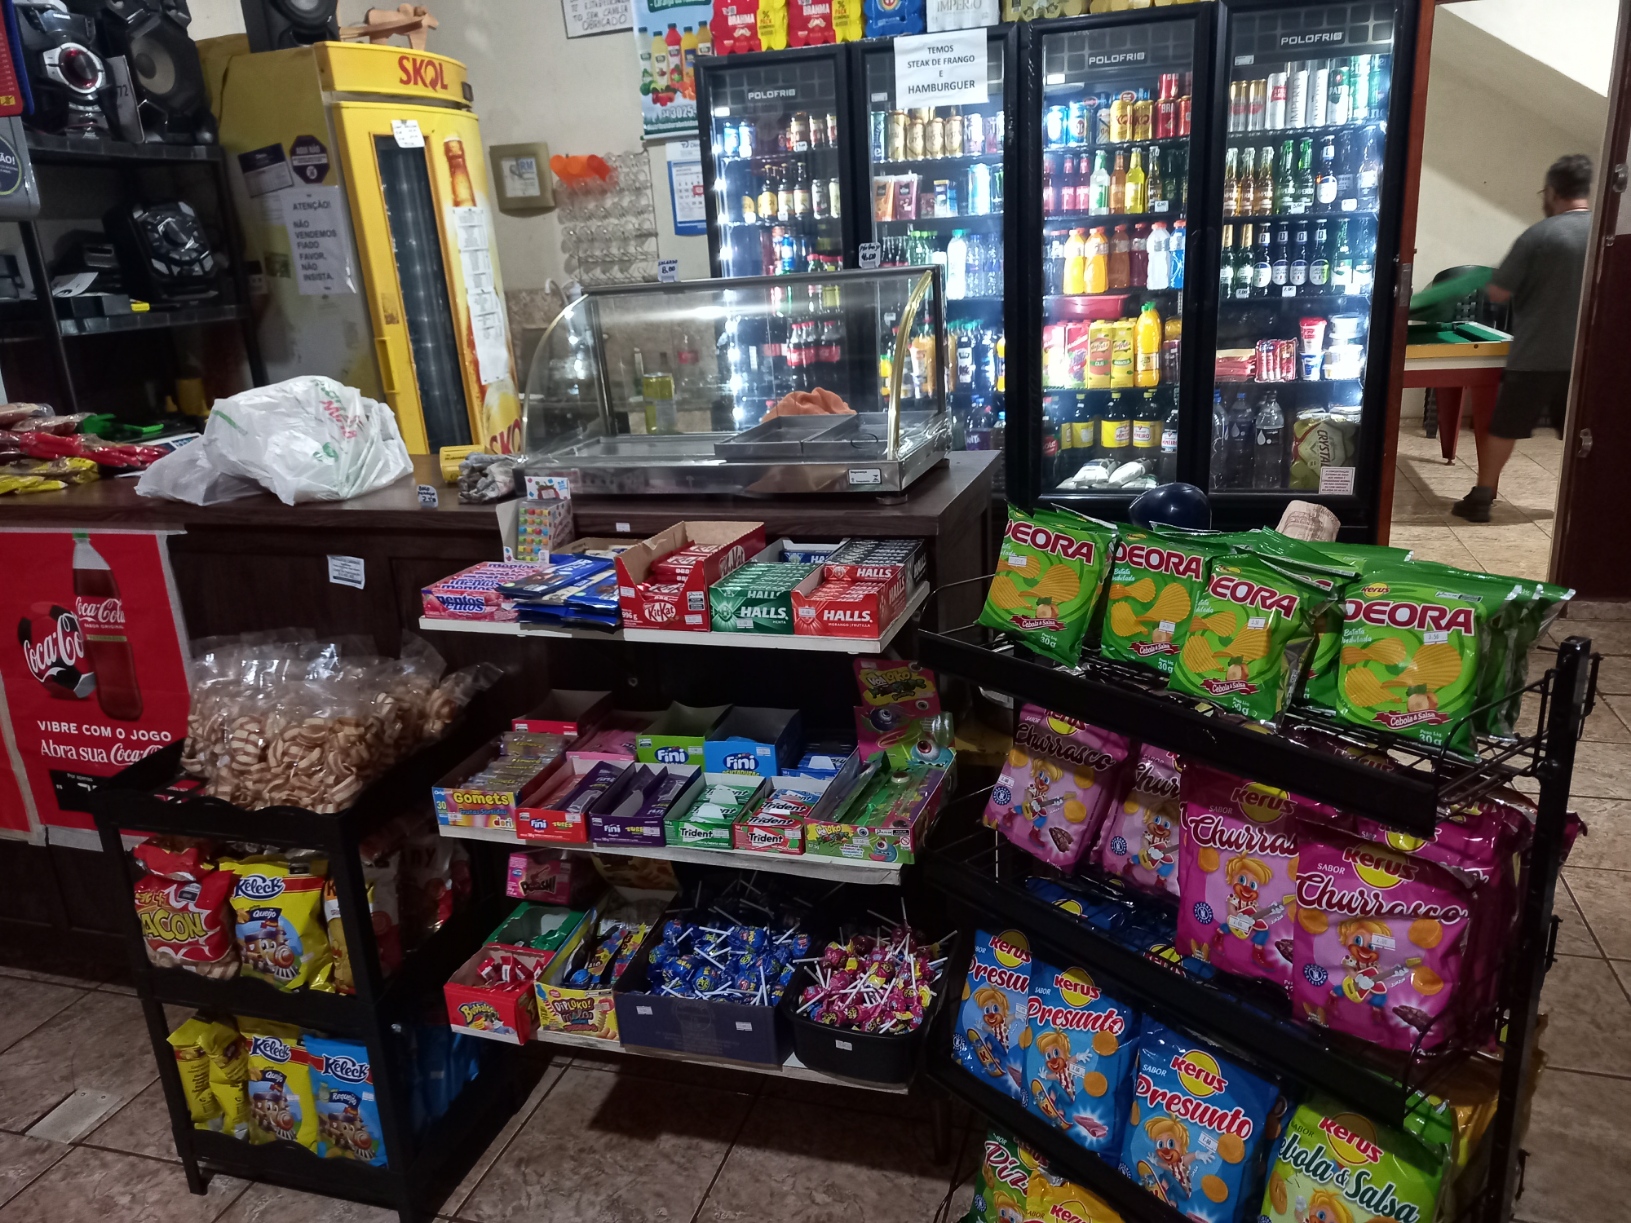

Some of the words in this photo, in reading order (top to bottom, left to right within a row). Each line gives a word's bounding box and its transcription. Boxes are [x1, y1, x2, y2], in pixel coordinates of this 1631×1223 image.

[927, 44, 954, 55] TEMOS
[907, 58, 930, 69] STEAK
[931, 57, 942, 67] DE
[943, 54, 975, 66] FRANGO
[398, 55, 448, 92] SKOL
[938, 70, 943, 78] E
[907, 79, 975, 95] HAMBURGUER
[293, 200, 332, 212] ATENÇÃO!
[293, 221, 310, 229] NÃO
[295, 229, 338, 239] VENDEMOS
[297, 240, 319, 250] FIADO
[301, 262, 318, 271] NÃO
[856, 567, 892, 579] HALLS
[740, 606, 787, 620] HALLS
[823, 609, 871, 622] HALLS
[1022, 619, 1038, 628] Cebola
[1139, 645, 1155, 655] Cebola
[1211, 683, 1230, 694] Cebola
[1232, 681, 1246, 689] Salsa
[1390, 715, 1413, 727] Cebola
[1418, 712, 1436, 720] Salsa
[37, 720, 79, 734] VIBRE
[81, 724, 112, 738] COM
[116, 727, 126, 739] O
[130, 729, 172, 742] JOGO
[40, 739, 78, 760] Abra
[80, 747, 109, 764] sua
[1015, 722, 1117, 772] Churrasco
[453, 792, 510, 806] Gomets
[1230, 786, 1299, 816] kerus
[1208, 804, 1233, 815] SABOR
[680, 827, 714, 839] Trident
[749, 832, 783, 844] Trident
[1317, 862, 1346, 875] SABOR
[1343, 847, 1420, 883] kerus
[233, 873, 286, 901] Keleck
[1296, 872, 1469, 926] Churrasco
[989, 935, 1032, 965] kerus
[1034, 986, 1051, 996] SABOR
[1054, 974, 1102, 1001] kerus
[1027, 995, 1125, 1036] Presunto
[250, 1034, 292, 1064] Keleck
[321, 1053, 371, 1085] Keleck
[1142, 1063, 1168, 1078] SABOR
[1169, 1054, 1229, 1094] kerus
[1135, 1072, 1253, 1141] Presunto
[1318, 1115, 1385, 1164] kerus
[1333, 1166, 1352, 1189] &
[1343, 1168, 1422, 1223] Salsa
